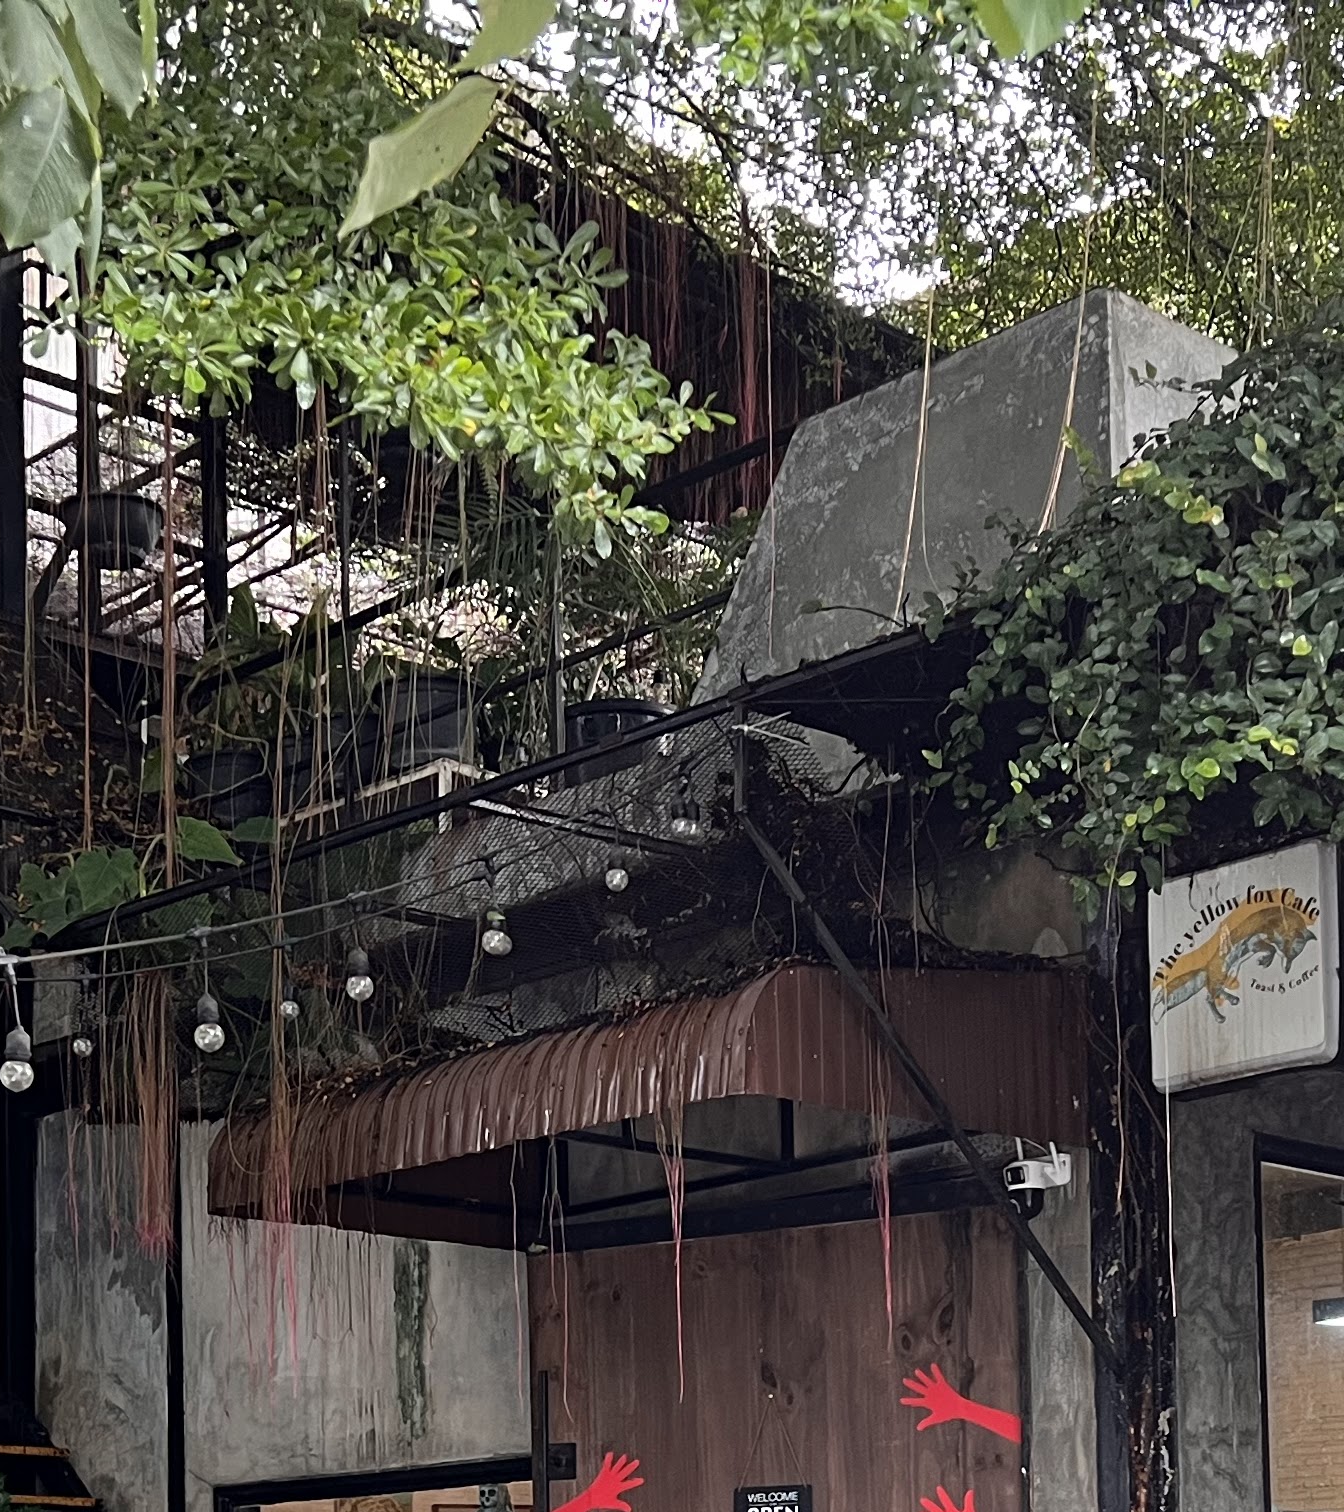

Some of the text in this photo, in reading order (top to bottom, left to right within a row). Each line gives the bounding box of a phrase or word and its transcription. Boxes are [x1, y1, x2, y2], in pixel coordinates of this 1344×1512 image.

[1153, 884, 1320, 982] The yellow fox Cafe
[1278, 982, 1286, 994] &
[747, 1491, 799, 1503] WELCOME
